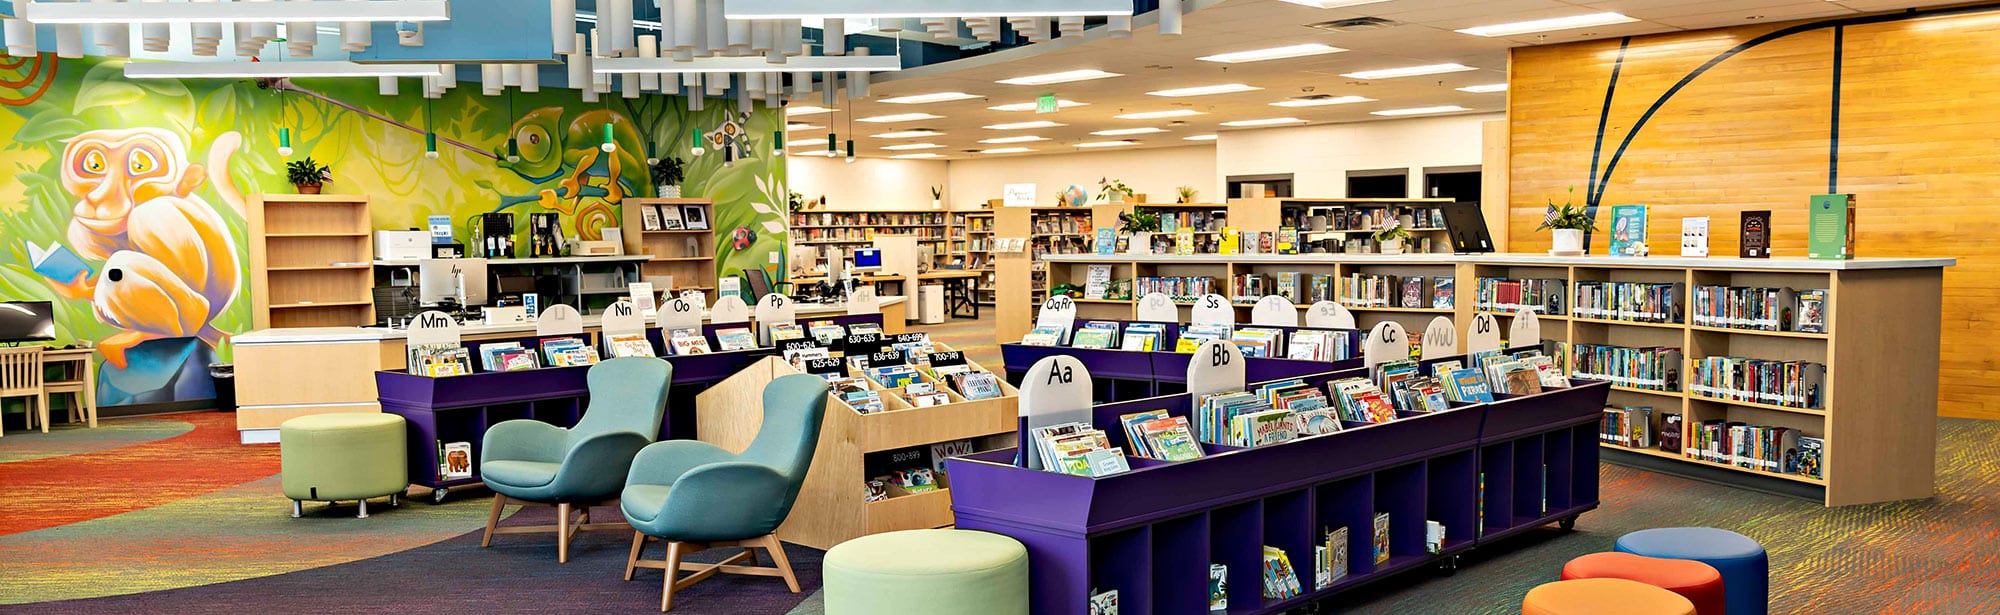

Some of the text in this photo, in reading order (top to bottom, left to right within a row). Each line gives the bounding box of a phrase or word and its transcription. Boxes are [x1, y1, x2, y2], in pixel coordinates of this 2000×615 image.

[674, 299, 690, 312] Oo
[771, 295, 783, 309] Pp
[1206, 295, 1219, 309] Ss
[615, 302, 632, 317] Nn
[421, 313, 448, 328] Mm
[1477, 315, 1490, 334] Dd
[848, 334, 876, 344] 630-635
[1382, 323, 1396, 343] Cc
[873, 351, 900, 361] 636-639
[933, 352, 959, 361] 700-749
[1212, 343, 1230, 367] Bb
[812, 358, 840, 368] 625-629
[1047, 358, 1073, 385] Aa
[1268, 431, 1287, 442] FRIEND
